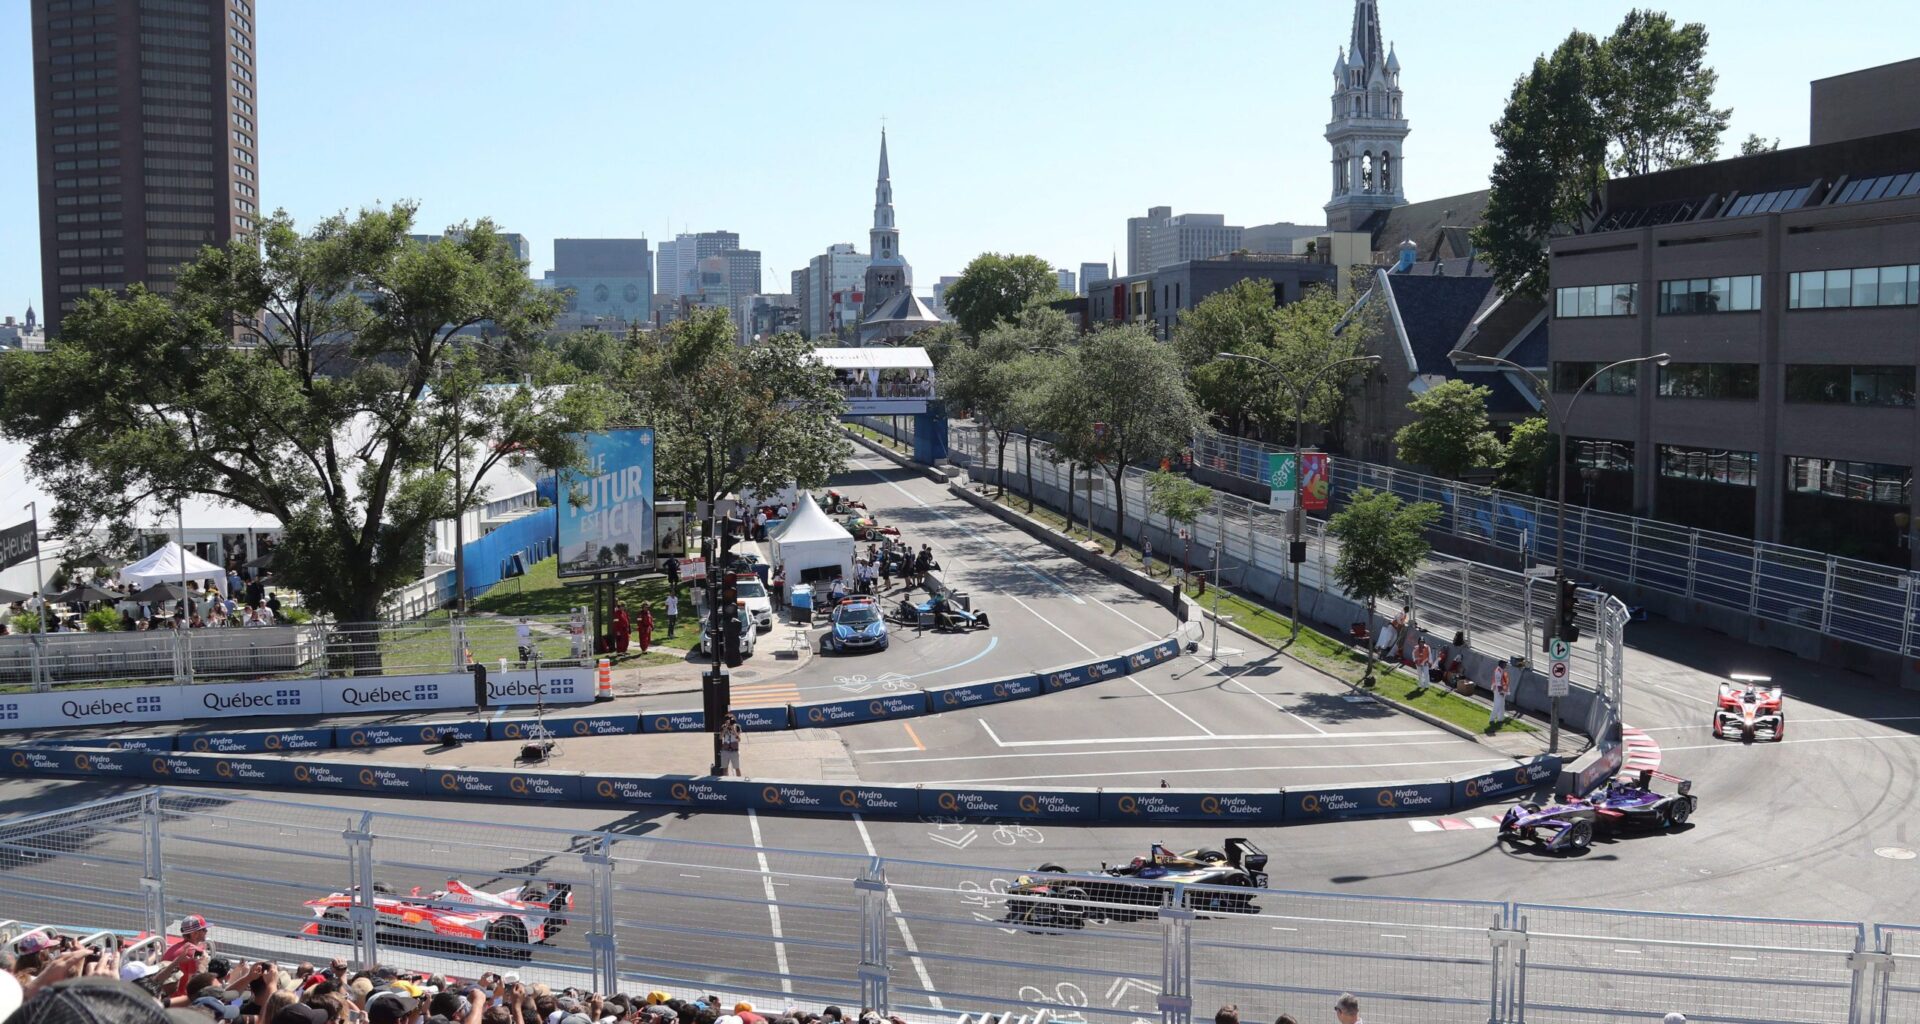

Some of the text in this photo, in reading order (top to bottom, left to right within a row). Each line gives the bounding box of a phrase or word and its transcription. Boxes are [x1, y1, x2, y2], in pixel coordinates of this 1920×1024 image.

[581, 512, 600, 533] EST
[1096, 663, 1109, 671] Hydro
[1059, 671, 1071, 680] Hydro
[1064, 676, 1080, 684] Québec
[486, 681, 548, 699] Québec
[1004, 681, 1020, 690] Hydro
[1011, 686, 1031, 694] Québec
[342, 686, 412, 705] Québec
[954, 689, 971, 697] Hydro
[961, 693, 982, 702] Québec
[203, 692, 274, 711] Québec
[883, 698, 902, 707] Hydro
[61, 700, 134, 719] Québec
[822, 706, 842, 714] Hydro
[891, 704, 915, 712] Québec
[671, 715, 692, 724] Hydro
[738, 712, 759, 721] Hydro
[830, 711, 855, 719] Québec
[590, 720, 611, 728] Hydro
[679, 722, 705, 730] Québec
[746, 718, 772, 726] Québec
[367, 730, 390, 738] Hydro
[436, 726, 459, 734] Hydro
[597, 726, 624, 734] Québec
[210, 737, 233, 746] Hydro
[281, 734, 304, 742] Hydro
[375, 736, 403, 744] Québec
[218, 743, 247, 751] Québec
[289, 739, 318, 748] Québec
[90, 755, 110, 763] Hydro
[167, 759, 188, 768] Hydro
[34, 760, 59, 768] Québec
[231, 762, 252, 771] Hydro
[175, 766, 200, 775] Québec
[239, 770, 265, 778] Québec
[309, 766, 330, 775] Hydro
[1526, 764, 1543, 775] Hydro
[317, 774, 343, 783] Québec
[375, 770, 396, 779] Hydro
[457, 774, 479, 784] Hydro
[1531, 770, 1551, 780] Québec
[382, 778, 409, 787] Québec
[526, 777, 549, 787] Hydro
[614, 782, 638, 790] Hydro
[1477, 776, 1494, 787] Hydro
[465, 782, 492, 791] Québec
[535, 785, 563, 794] Québec
[688, 784, 712, 793] Hydro
[1482, 782, 1504, 792] Québec
[623, 790, 652, 798] Québec
[697, 792, 727, 801] Québec
[781, 788, 804, 797] Hydro
[858, 791, 882, 800] Hydro
[1395, 789, 1418, 797] Hydro
[790, 796, 820, 805] Québec
[957, 793, 982, 803] Hydro
[1038, 795, 1064, 805] Hydro
[1137, 796, 1164, 806] Hydro
[1220, 797, 1246, 806] Hydro
[1320, 794, 1344, 802] Hydro
[1403, 796, 1432, 805] Québec
[867, 799, 898, 808] Québec
[966, 801, 998, 810] Québec
[1047, 804, 1080, 812] Québec
[1328, 800, 1358, 809] Québec
[1147, 804, 1180, 813] Québec
[1230, 805, 1262, 813] Québec
[1258, 878, 1267, 886] 25
[529, 928, 539, 937] 19
